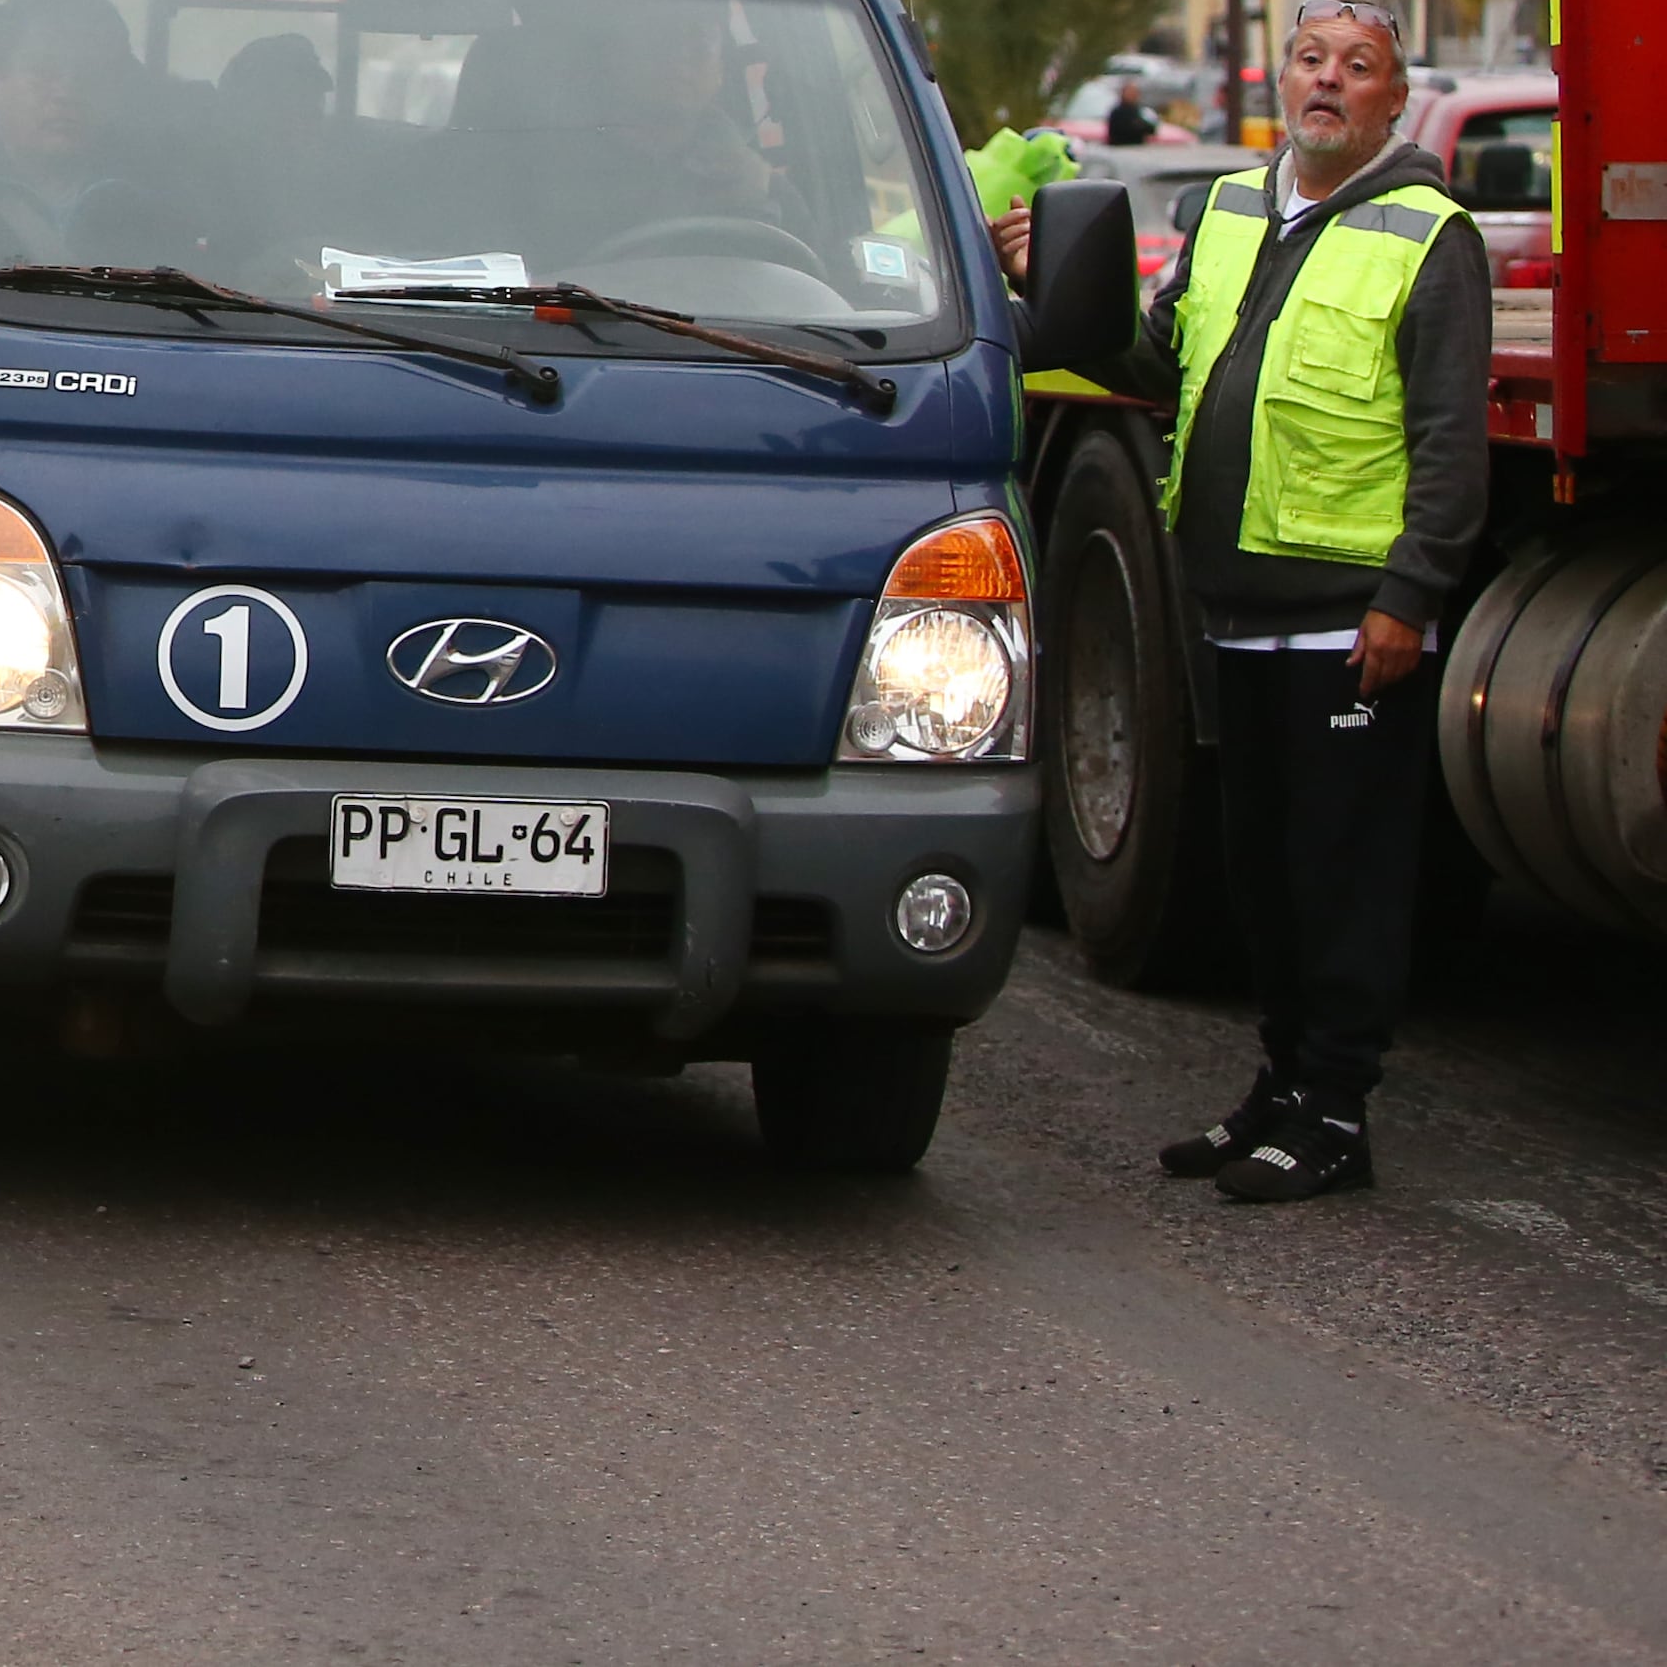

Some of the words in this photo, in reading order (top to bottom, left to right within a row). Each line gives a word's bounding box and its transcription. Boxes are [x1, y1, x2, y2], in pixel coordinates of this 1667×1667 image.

[54, 371, 138, 396] CRDi
[203, 604, 250, 710] 1
[1330, 713, 1368, 728] PUMA
[424, 871, 513, 886] CHILE
